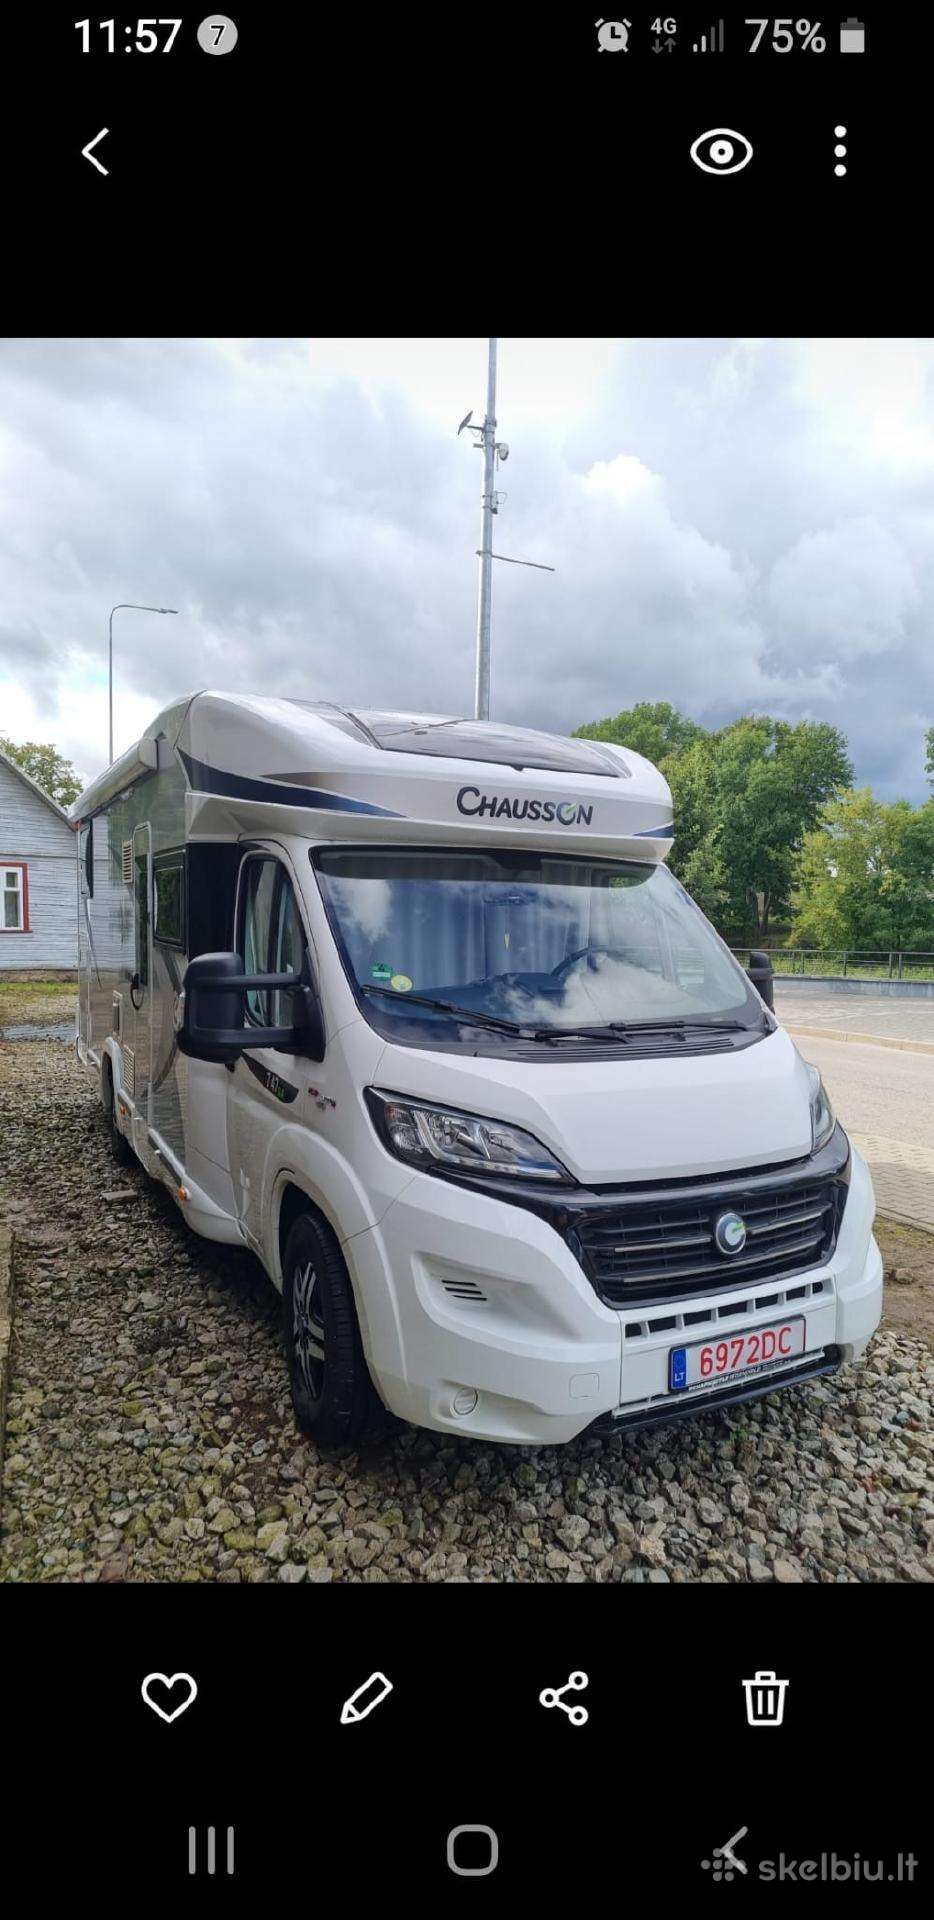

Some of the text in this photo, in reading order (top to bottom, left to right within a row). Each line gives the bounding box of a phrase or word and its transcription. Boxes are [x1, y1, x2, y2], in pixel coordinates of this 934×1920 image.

[456, 786, 594, 826] CHAUSSON
[700, 1326, 792, 1377] 6972DC
[673, 1371, 686, 1383] LT
